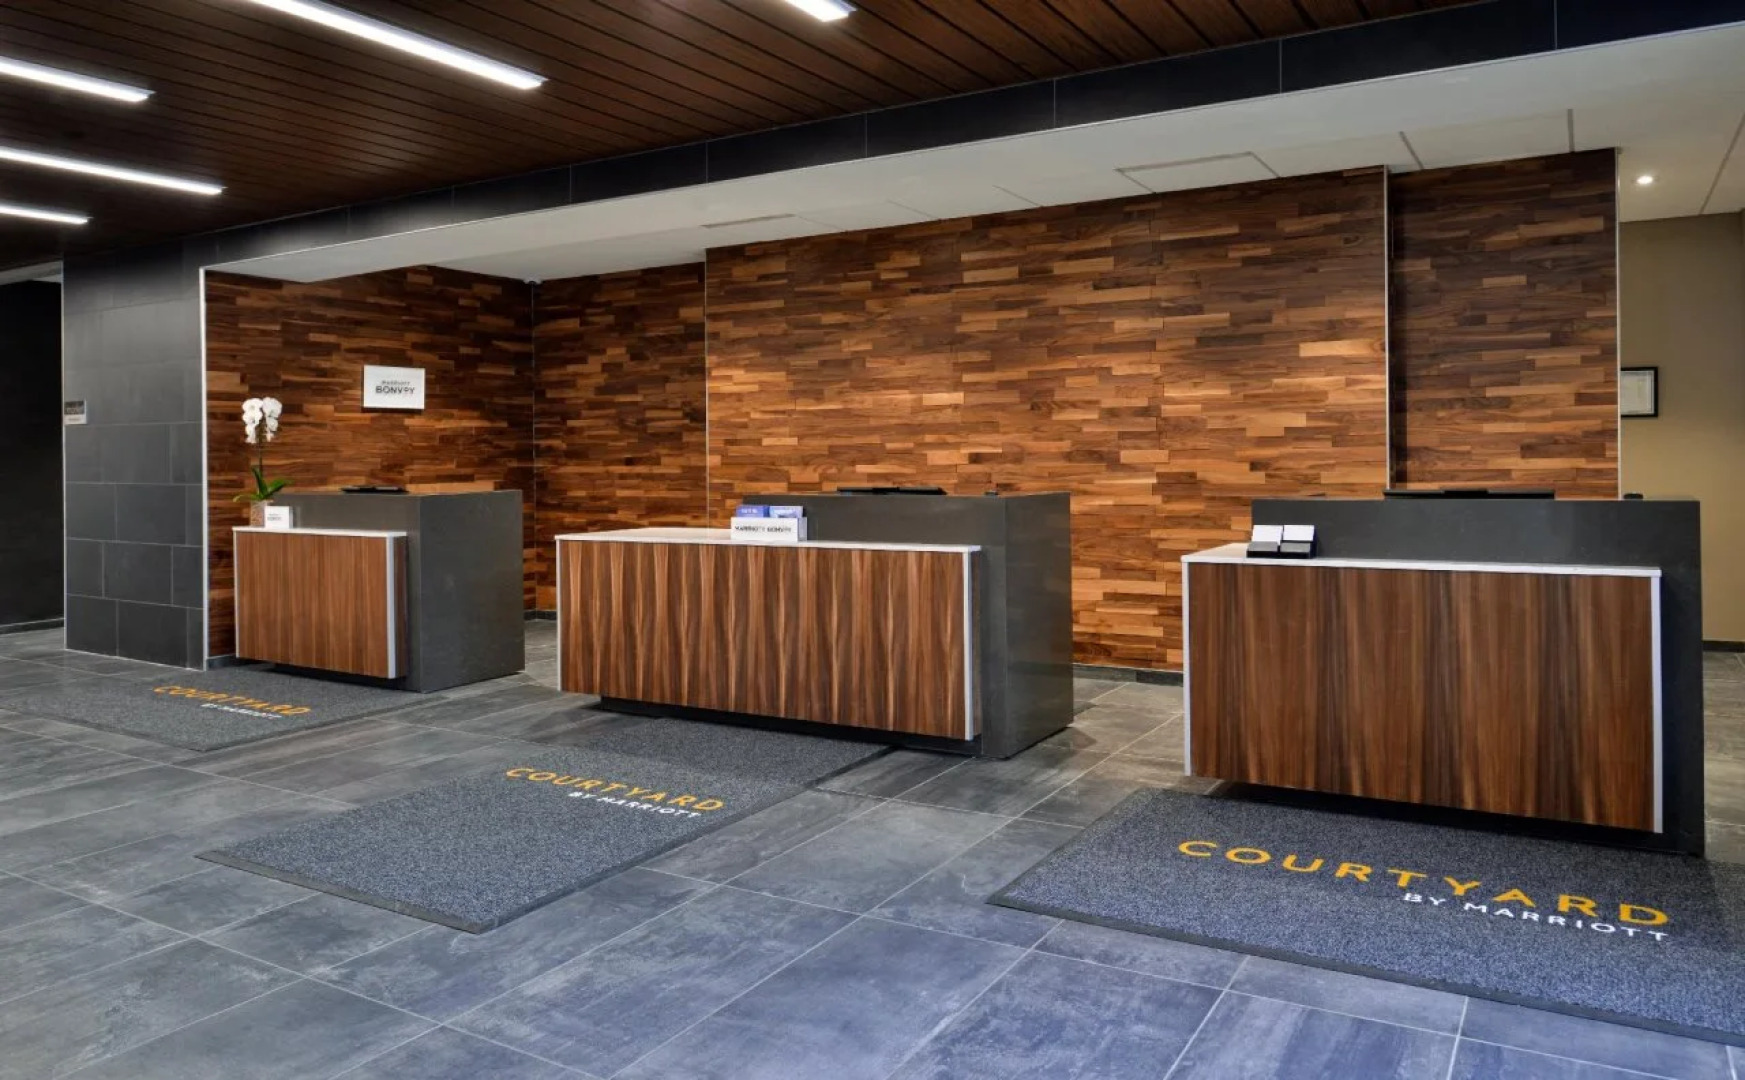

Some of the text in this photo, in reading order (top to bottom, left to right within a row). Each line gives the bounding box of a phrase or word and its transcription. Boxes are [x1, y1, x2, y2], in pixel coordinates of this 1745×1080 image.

[153, 686, 312, 715] COURTYARD
[506, 767, 724, 811] COURTYARD
[568, 791, 703, 818] BY MARRIOTT
[1178, 840, 1670, 927] COURTYARD
[1403, 891, 1669, 942] BY MARRIOTT
